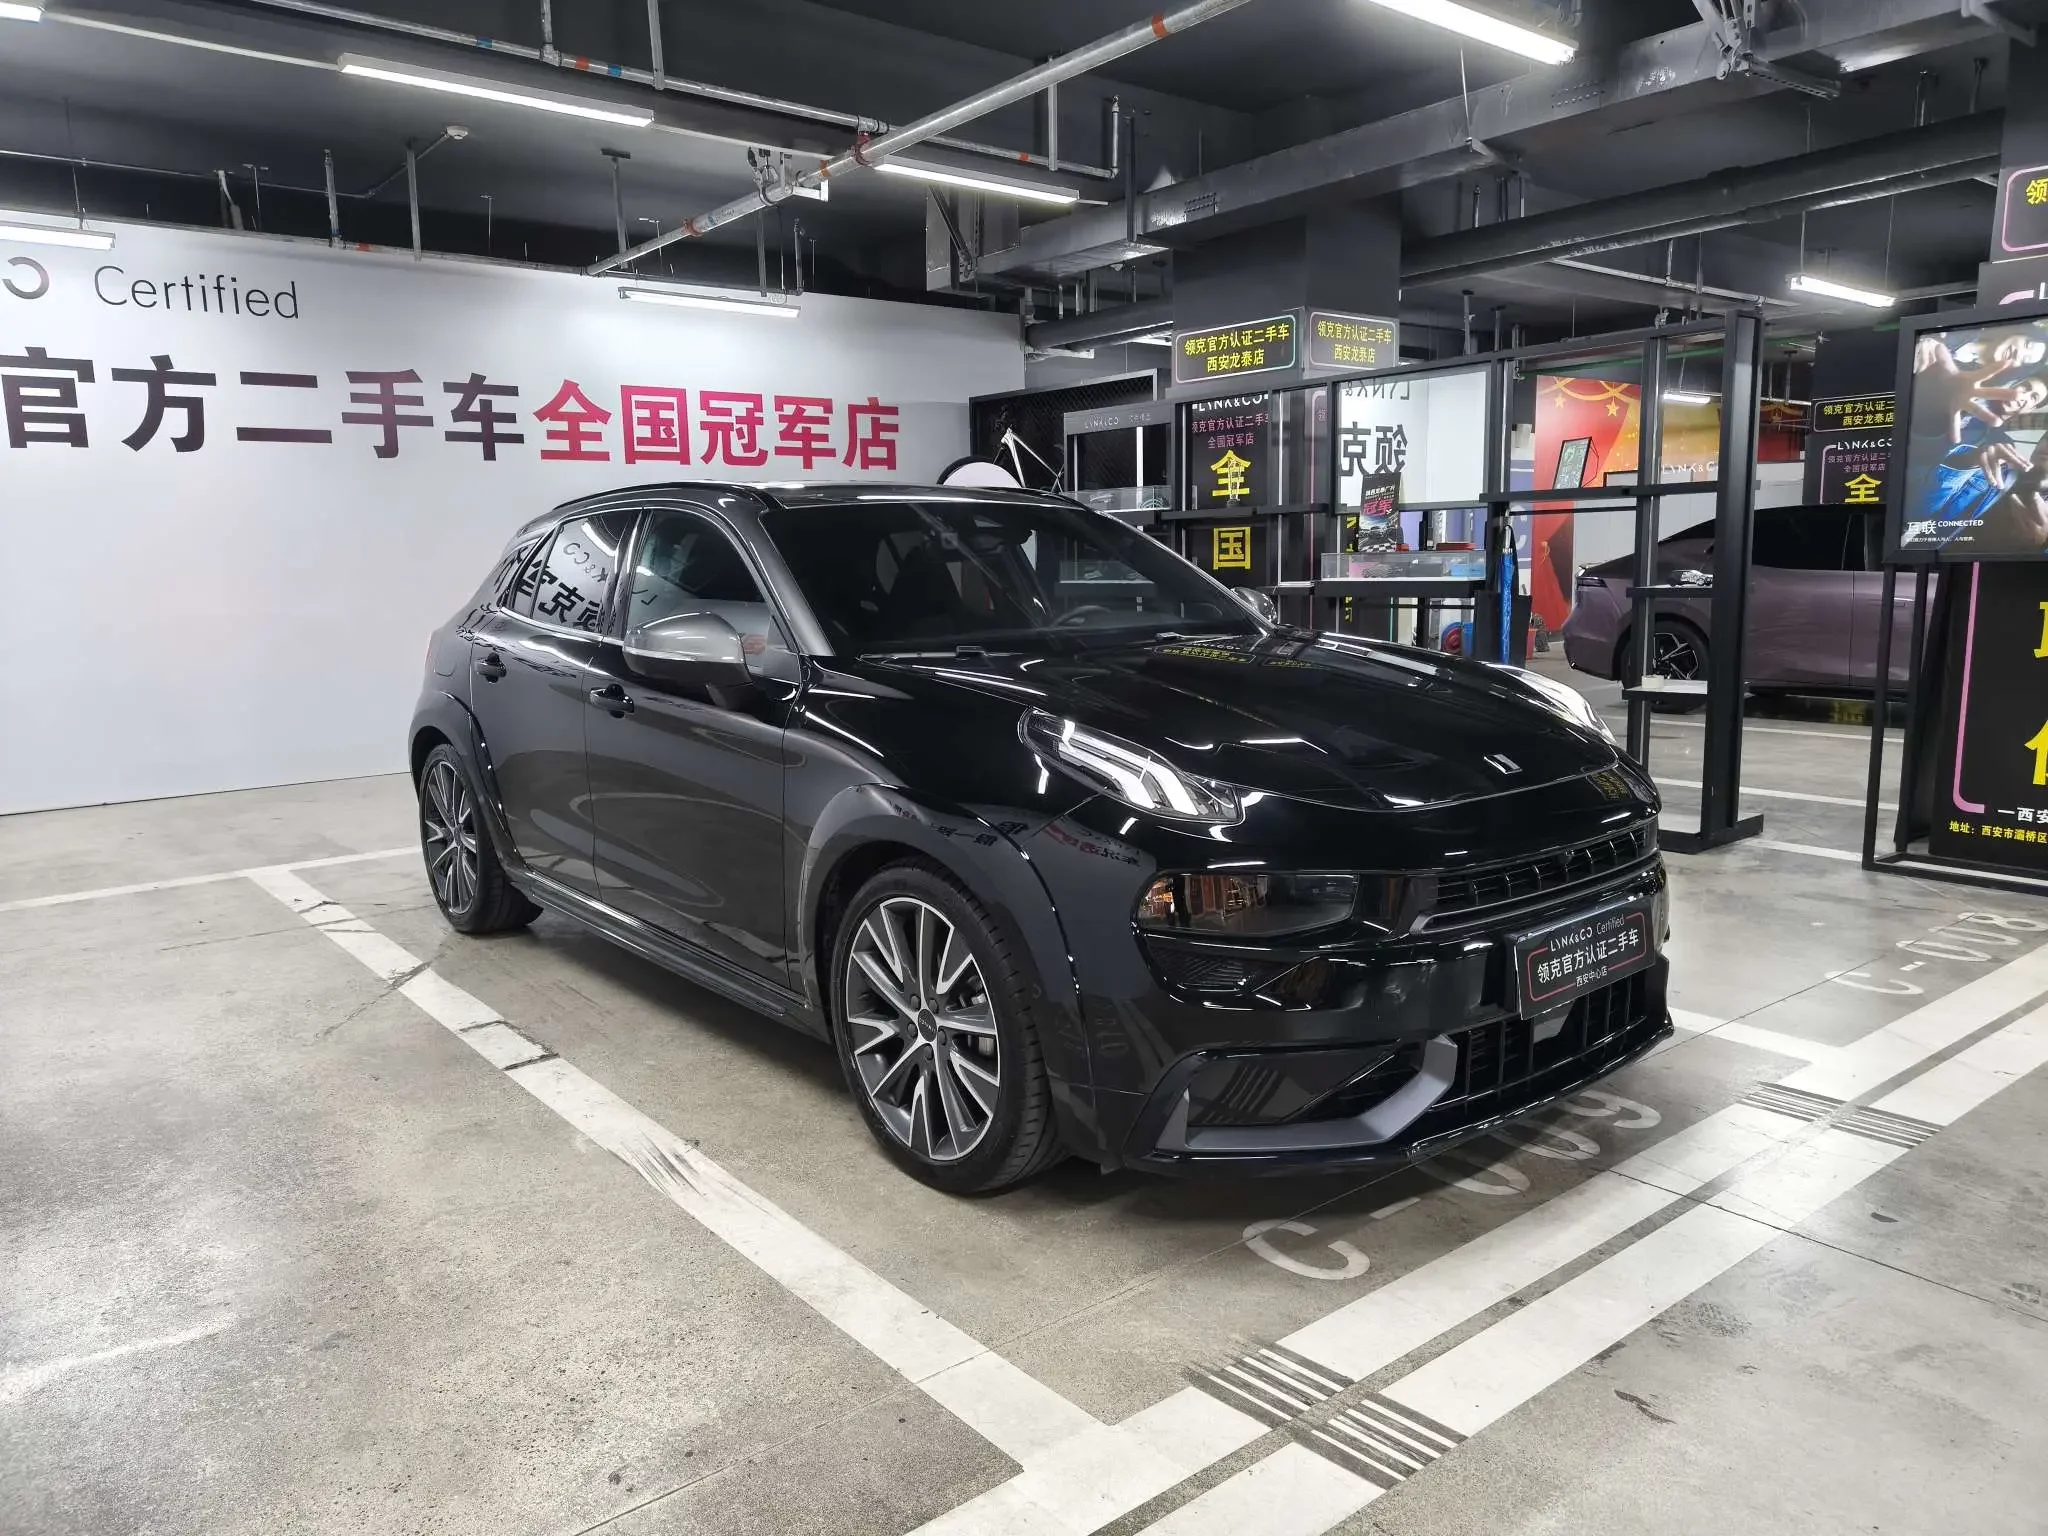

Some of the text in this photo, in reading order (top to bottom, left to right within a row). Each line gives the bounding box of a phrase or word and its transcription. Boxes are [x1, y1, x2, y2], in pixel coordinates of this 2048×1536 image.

[94, 265, 299, 319] Certified
[1184, 323, 1290, 355] 领克官方认证二手车
[1318, 320, 1392, 345] 领克官方认证二手车
[1207, 349, 1264, 373] 西安龙泰店
[1334, 344, 1375, 364] 西安龙泰店
[1208, 432, 1254, 449] 全国冠军店
[1844, 474, 1882, 503] 全
[1937, 519, 1984, 528] CONNECTED
[1550, 914, 1625, 952] LYNK&CO Certified
[1537, 928, 1639, 984] 领克官方认证二手车
[1576, 966, 1608, 987] 西安中心店
